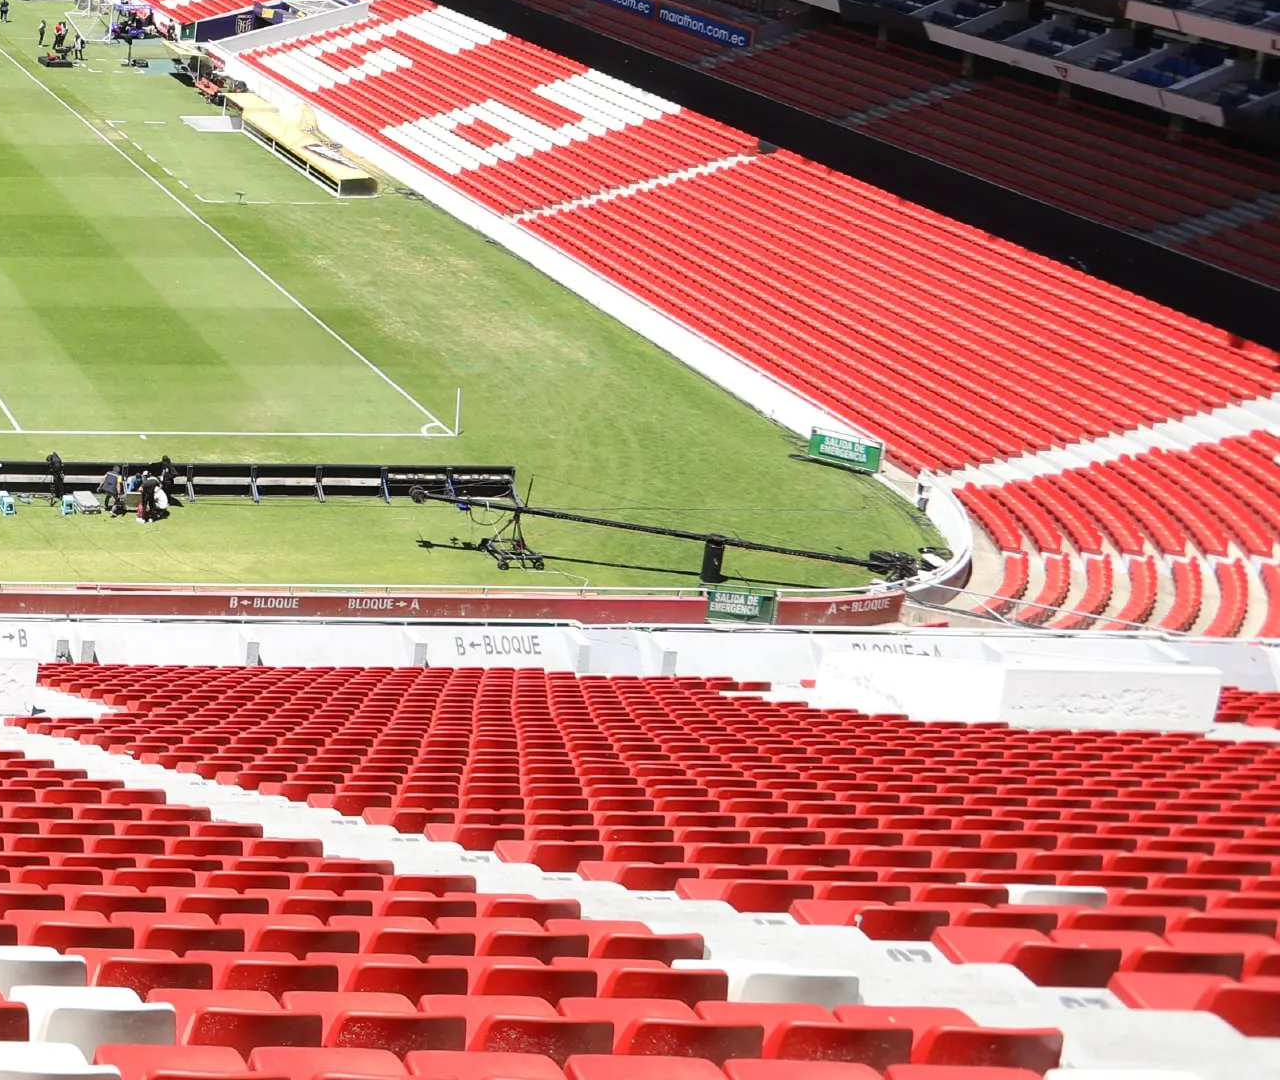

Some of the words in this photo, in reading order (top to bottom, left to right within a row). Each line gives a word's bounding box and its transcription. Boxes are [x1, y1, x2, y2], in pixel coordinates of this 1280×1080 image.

[658, 7, 746, 48] marathon.com.ec
[824, 436, 853, 452] SALIDA
[853, 442, 866, 453] DE
[819, 444, 868, 463] EMERGENCIA
[229, 596, 239, 609] B
[252, 596, 300, 609] BLOQUE
[347, 597, 395, 610] BLOQUE
[410, 597, 421, 610] A
[714, 592, 744, 605] SALIDA
[746, 594, 759, 607] DE
[827, 602, 838, 615] A
[850, 598, 890, 613] BLOQUE
[709, 601, 760, 617] EMERGENCIA
[18, 628, 28, 648] B
[454, 636, 467, 656] B
[481, 634, 543, 656] BLOQUE
